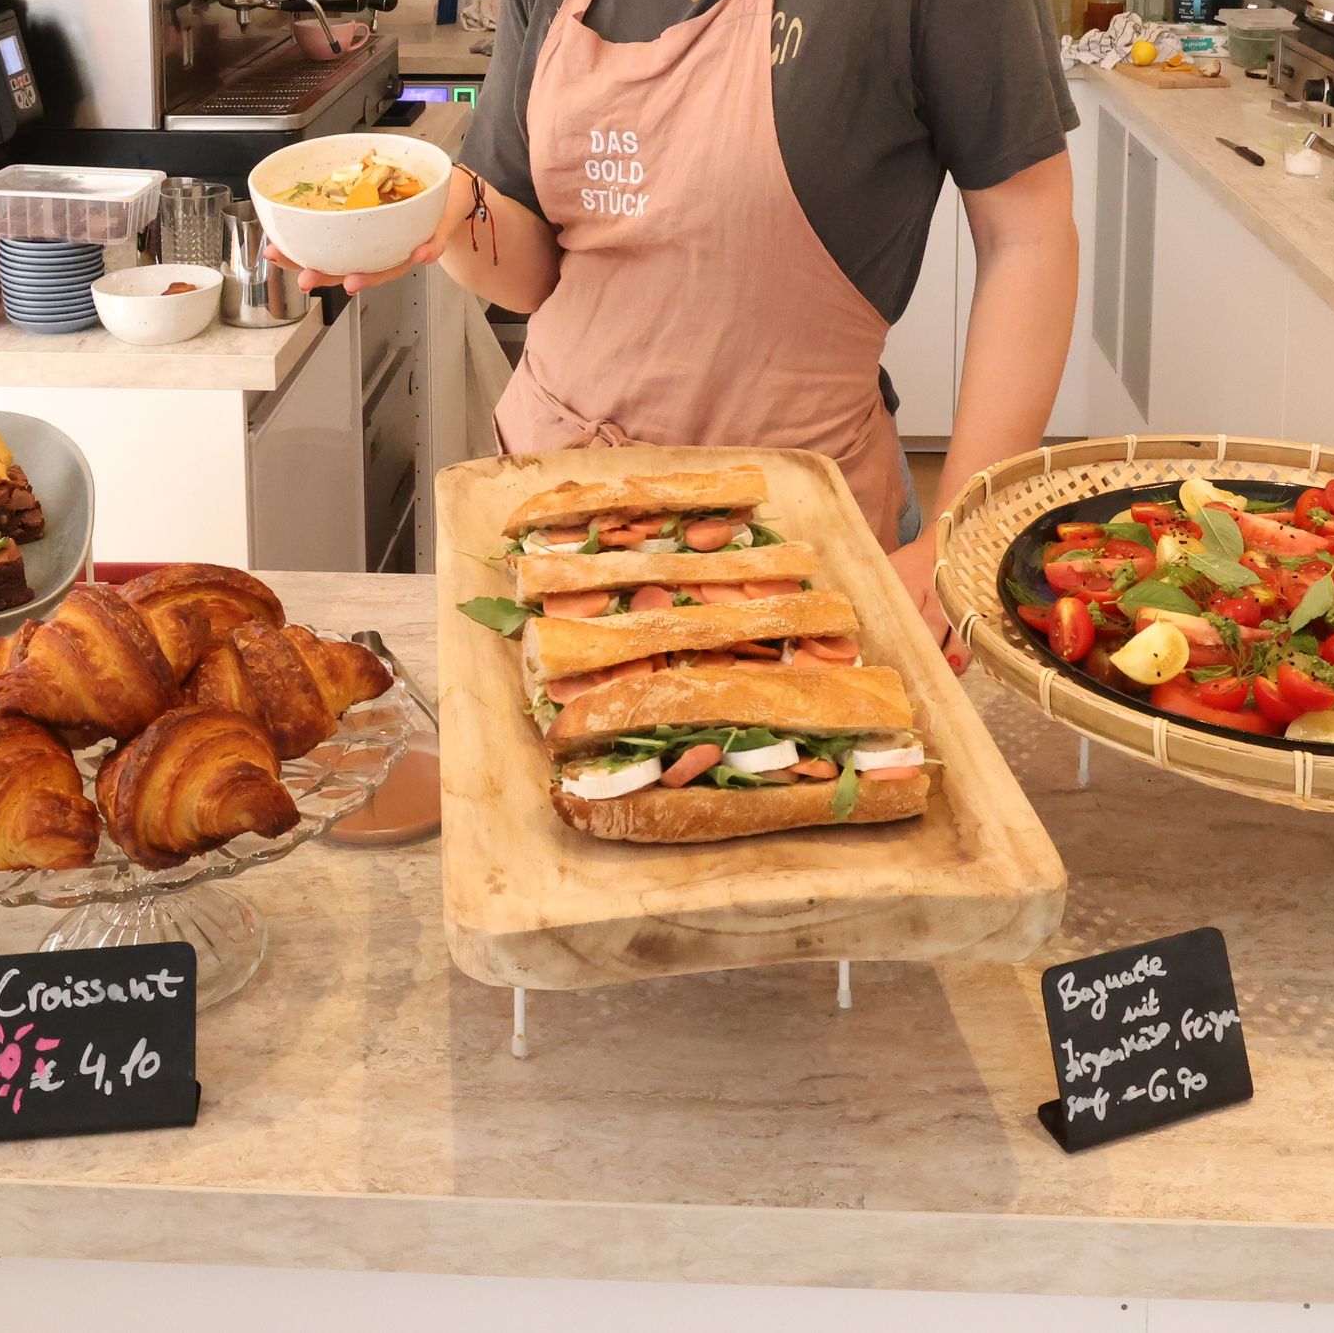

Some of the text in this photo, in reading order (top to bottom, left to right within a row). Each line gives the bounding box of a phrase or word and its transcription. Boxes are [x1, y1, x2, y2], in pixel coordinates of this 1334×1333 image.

[590, 130, 638, 154] DAS
[585, 160, 644, 185] GOLD
[581, 186, 650, 217] STÜCK
[1122, 987, 1160, 1023] mit
